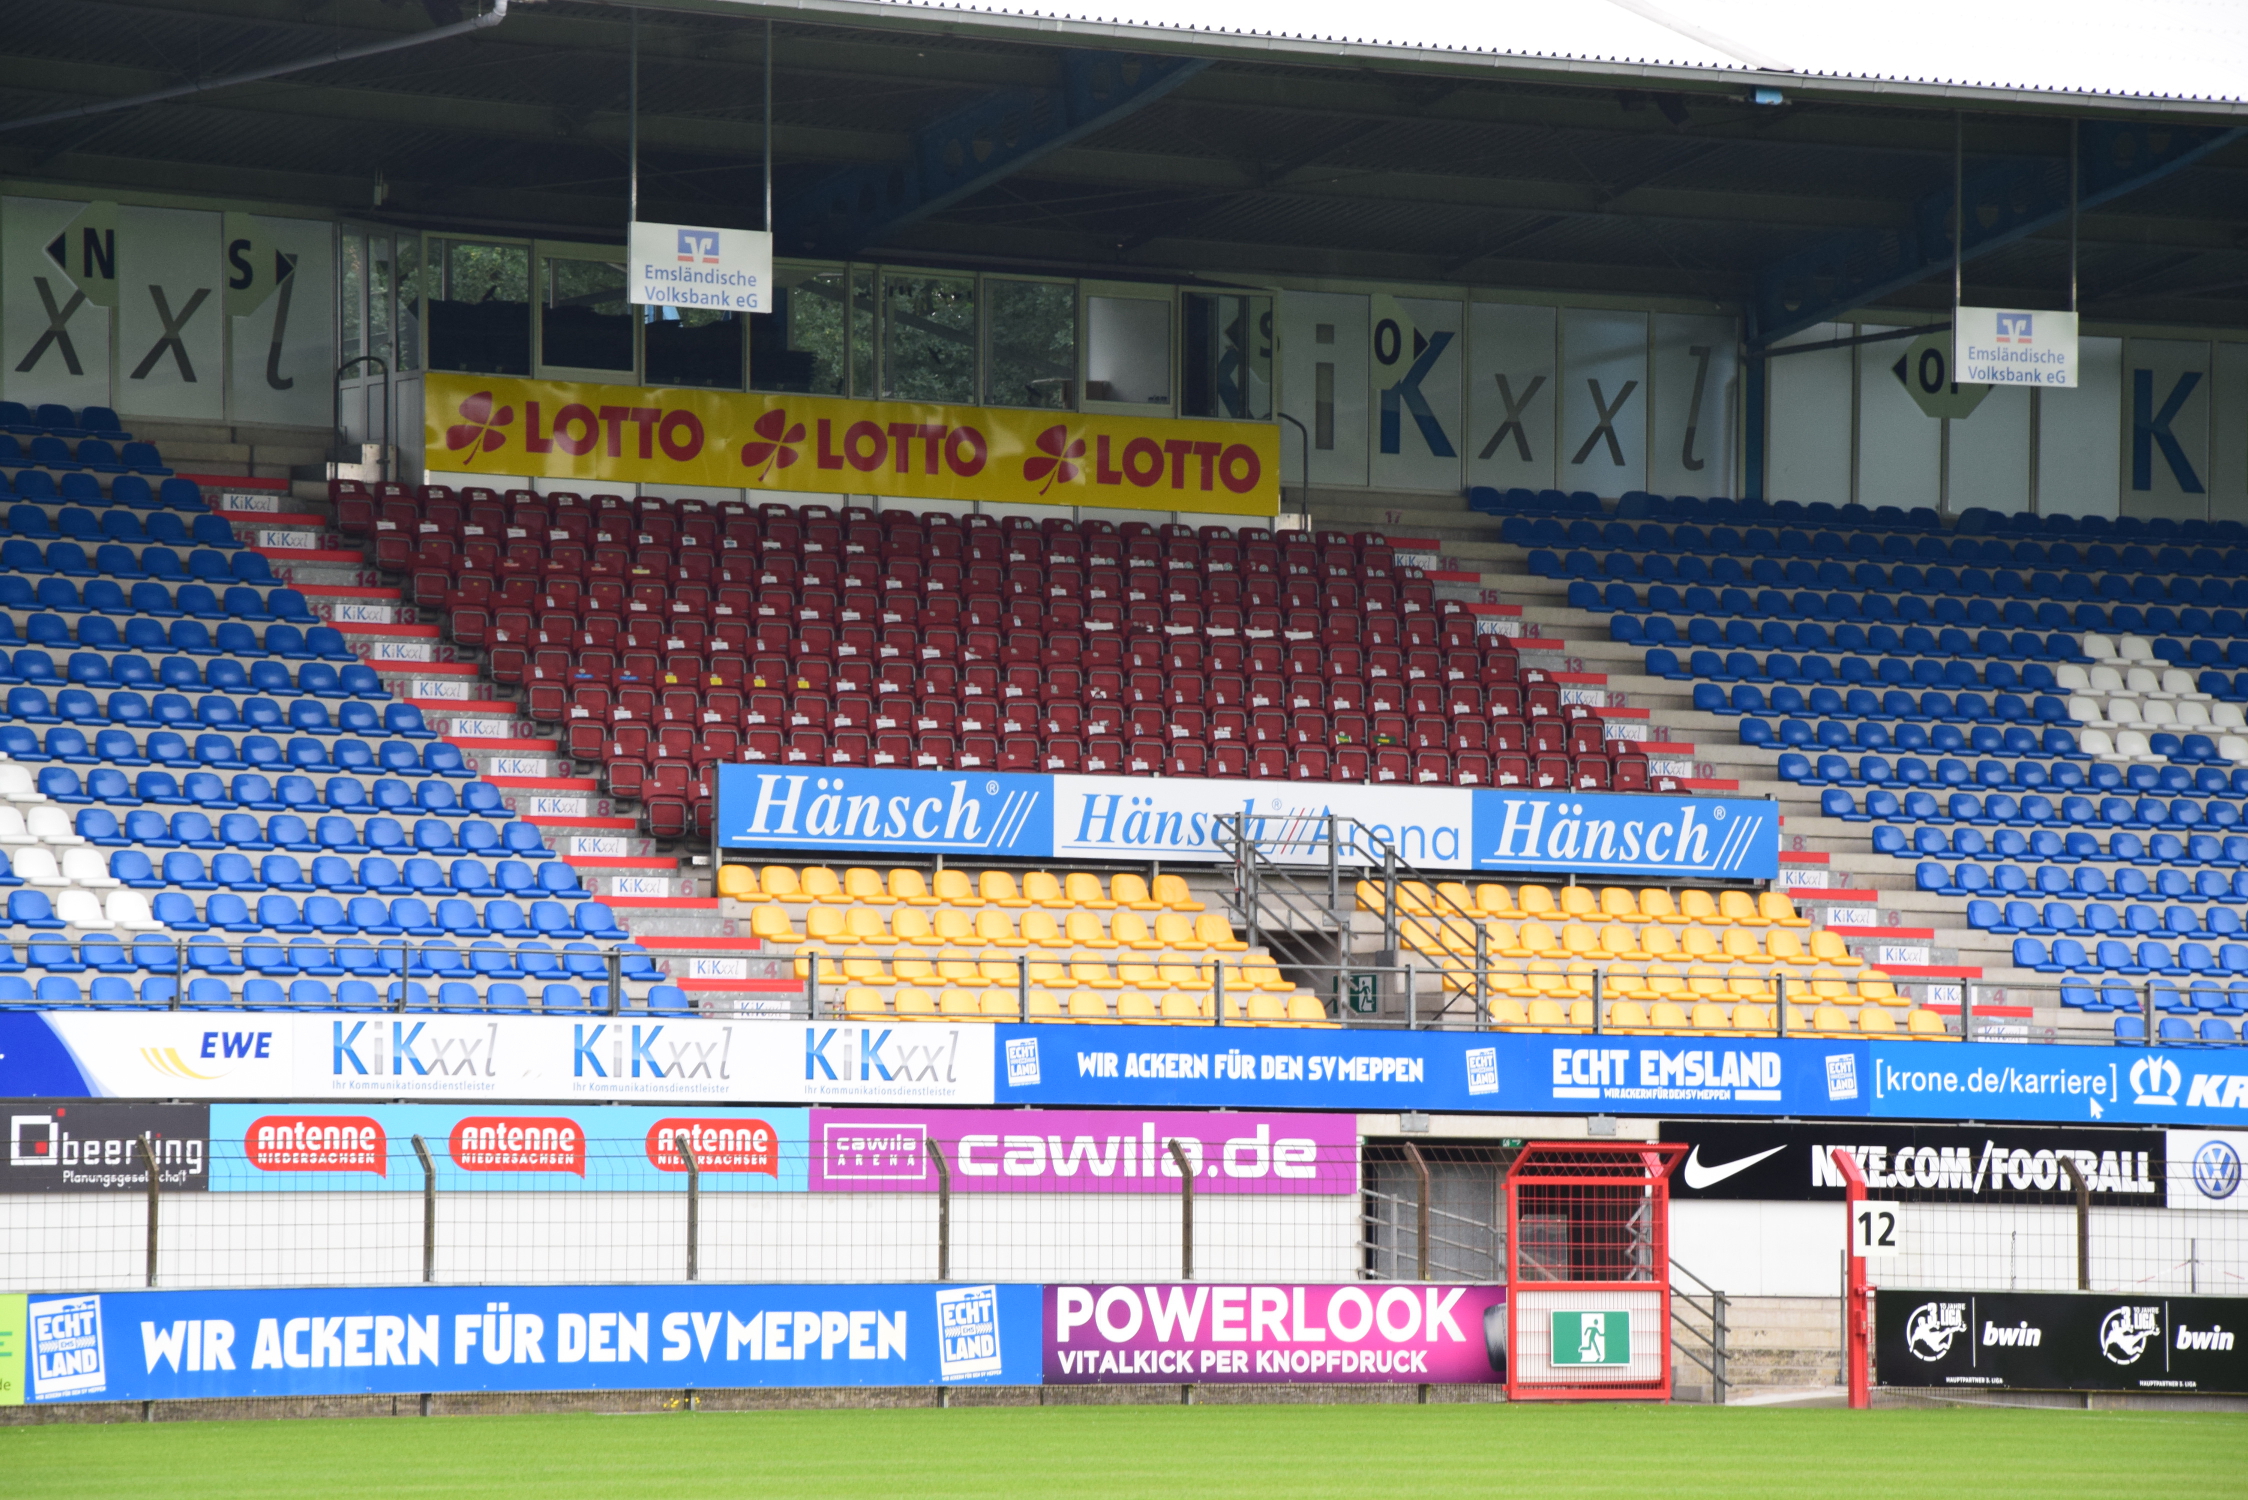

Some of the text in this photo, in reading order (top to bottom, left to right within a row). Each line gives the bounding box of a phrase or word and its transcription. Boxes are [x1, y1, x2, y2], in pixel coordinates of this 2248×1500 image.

[83, 228, 115, 280] N
[228, 240, 253, 290] S
[645, 265, 757, 287] Emsländische
[645, 286, 757, 308] Volksbank eG
[1968, 346, 2065, 365] Emsländische
[1968, 367, 2065, 384] Volksbank eG
[525, 400, 706, 463] LOTTO
[818, 417, 988, 478] LOTTO
[1096, 436, 1261, 493] LOTTO
[318, 534, 339, 550] 15
[356, 571, 377, 587] 14
[1479, 589, 1498, 604] 15
[343, 606, 384, 622] KiKxxl
[394, 608, 415, 624] 13
[1520, 623, 1540, 638] 14
[382, 644, 422, 660] KiKxxl
[433, 646, 455, 662] 12
[1564, 658, 1583, 673] 13
[420, 683, 461, 698] KiKxxl
[474, 684, 493, 700] 11
[1607, 692, 1625, 707] 12
[459, 720, 500, 736] KiKxxl
[510, 722, 533, 738] 10
[1653, 726, 1669, 742] 11
[498, 760, 539, 775] KiKxxl
[558, 762, 571, 777] 9
[1694, 763, 1714, 779] 10
[538, 799, 580, 814] KiKxxl
[598, 800, 610, 816] 8
[1307, 805, 1460, 861] Arena
[578, 838, 619, 854] KiKxxl
[639, 840, 651, 856] 7
[1793, 836, 1803, 851] 8
[586, 878, 598, 894] 6
[619, 878, 660, 893] KiKxxl
[1786, 871, 1822, 886] KiKxxl
[1839, 872, 1849, 888] 7
[680, 880, 693, 896] 6
[1834, 910, 1871, 924] KiKxxl
[1889, 911, 1899, 926] 6
[723, 920, 734, 936] 5
[1886, 948, 1922, 962] KiKxxl
[697, 960, 739, 976] KiKxxl
[764, 961, 777, 977] 4
[1993, 989, 2004, 1004] 4
[200, 1031, 273, 1059] EWE
[332, 1021, 500, 1077] KiKxxl
[574, 1024, 733, 1080] KiKxxl
[1009, 1045, 1035, 1059] ECHT
[805, 1027, 958, 1085] KiKxxl
[1469, 1055, 1493, 1069] ECHT
[1011, 1062, 1037, 1077] LAND
[1077, 1051, 1118, 1079] WIR
[1124, 1052, 1209, 1081] ACKERN
[1214, 1048, 1257, 1080] FÜR
[1261, 1054, 1303, 1081] DEN
[1553, 1048, 1781, 1089] ECHT EMSLAND
[1829, 1061, 1853, 1075] ECHT
[332, 1080, 496, 1091] Ihr Kommunikationsdienstleister
[1471, 1072, 1496, 1086] LAND
[1831, 1077, 1855, 1091] LAND
[573, 1083, 730, 1094] Ihr Kommunikationsdienstleister
[805, 1085, 957, 1097] Ihr Kommunikationsdienstleister
[258, 1121, 376, 1151] antenne
[462, 1123, 575, 1151] antenne
[836, 1134, 917, 1151] cawila
[257, 1153, 375, 1164] NIEDERSACHSEN
[958, 1122, 1317, 1179] cawila.de
[462, 1153, 575, 1165] NIEDERSACHSEN
[658, 1155, 767, 1165] NIERSACHSEN
[1857, 1211, 1896, 1246] 12
[943, 1299, 991, 1327] ECHT
[1055, 1285, 1467, 1343] POWERLOOK
[1940, 1309, 1962, 1326] LIGA
[37, 1310, 94, 1341] ECHT
[2134, 1313, 2156, 1330] LIGA
[140, 1320, 236, 1375] WIR
[251, 1314, 439, 1370] ACKERN
[454, 1302, 545, 1365] FÜR
[558, 1311, 649, 1364] DEN
[1983, 1320, 2041, 1347] bwin
[2176, 1324, 2235, 1351] bwin
[945, 1334, 994, 1361] LAND
[39, 1348, 97, 1379] LAND
[1058, 1350, 1427, 1374] VITALKICK PER KNOPFDRUCK
